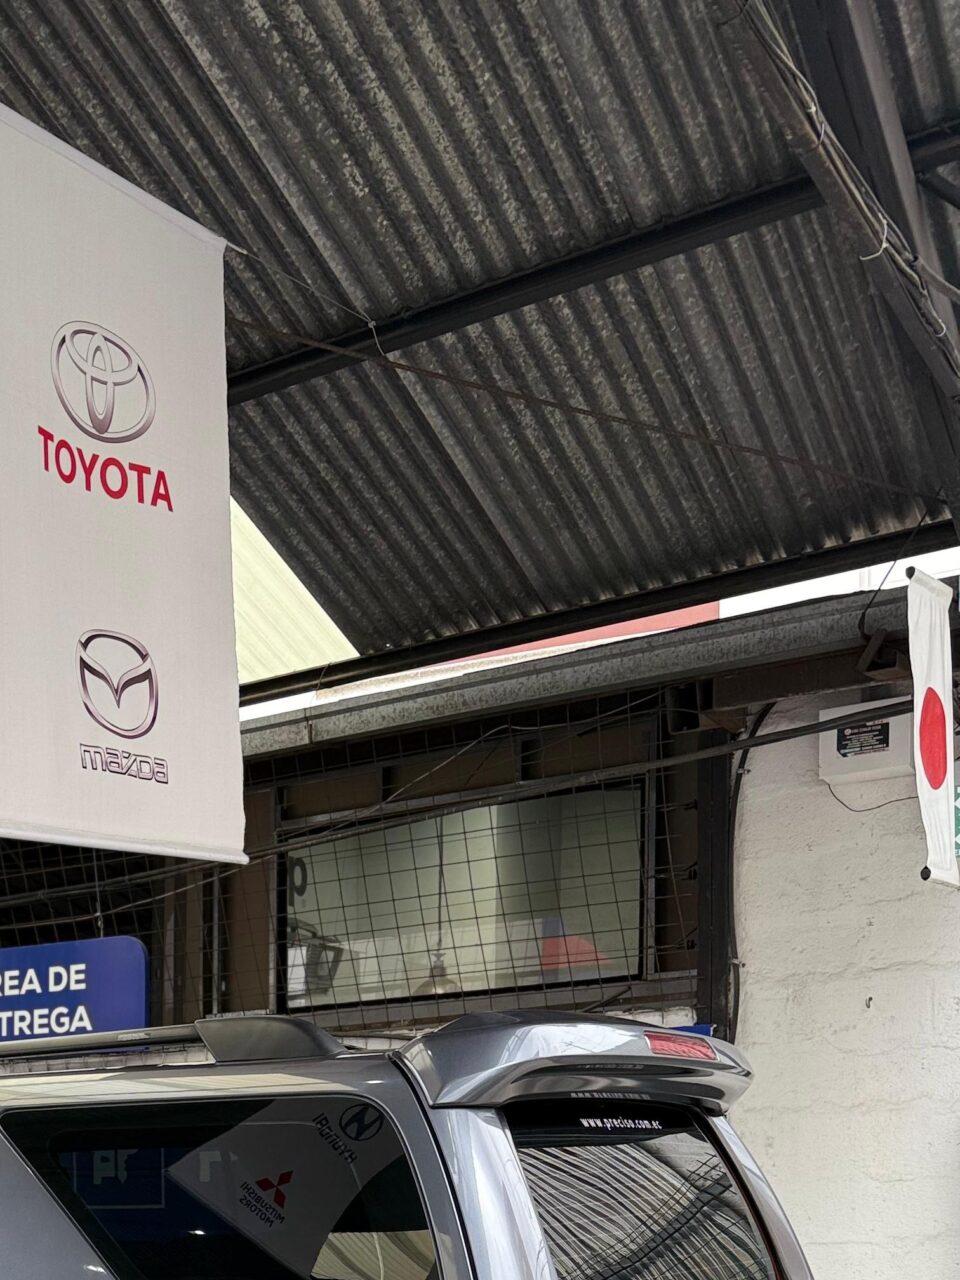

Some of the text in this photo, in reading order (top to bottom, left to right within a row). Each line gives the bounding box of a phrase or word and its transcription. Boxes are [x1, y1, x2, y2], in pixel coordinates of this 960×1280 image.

[37, 425, 174, 512] TOYOTA
[79, 742, 170, 785] mazda
[48, 963, 86, 992] DE
[579, 1116, 662, 1130] www.preciso.com.ec
